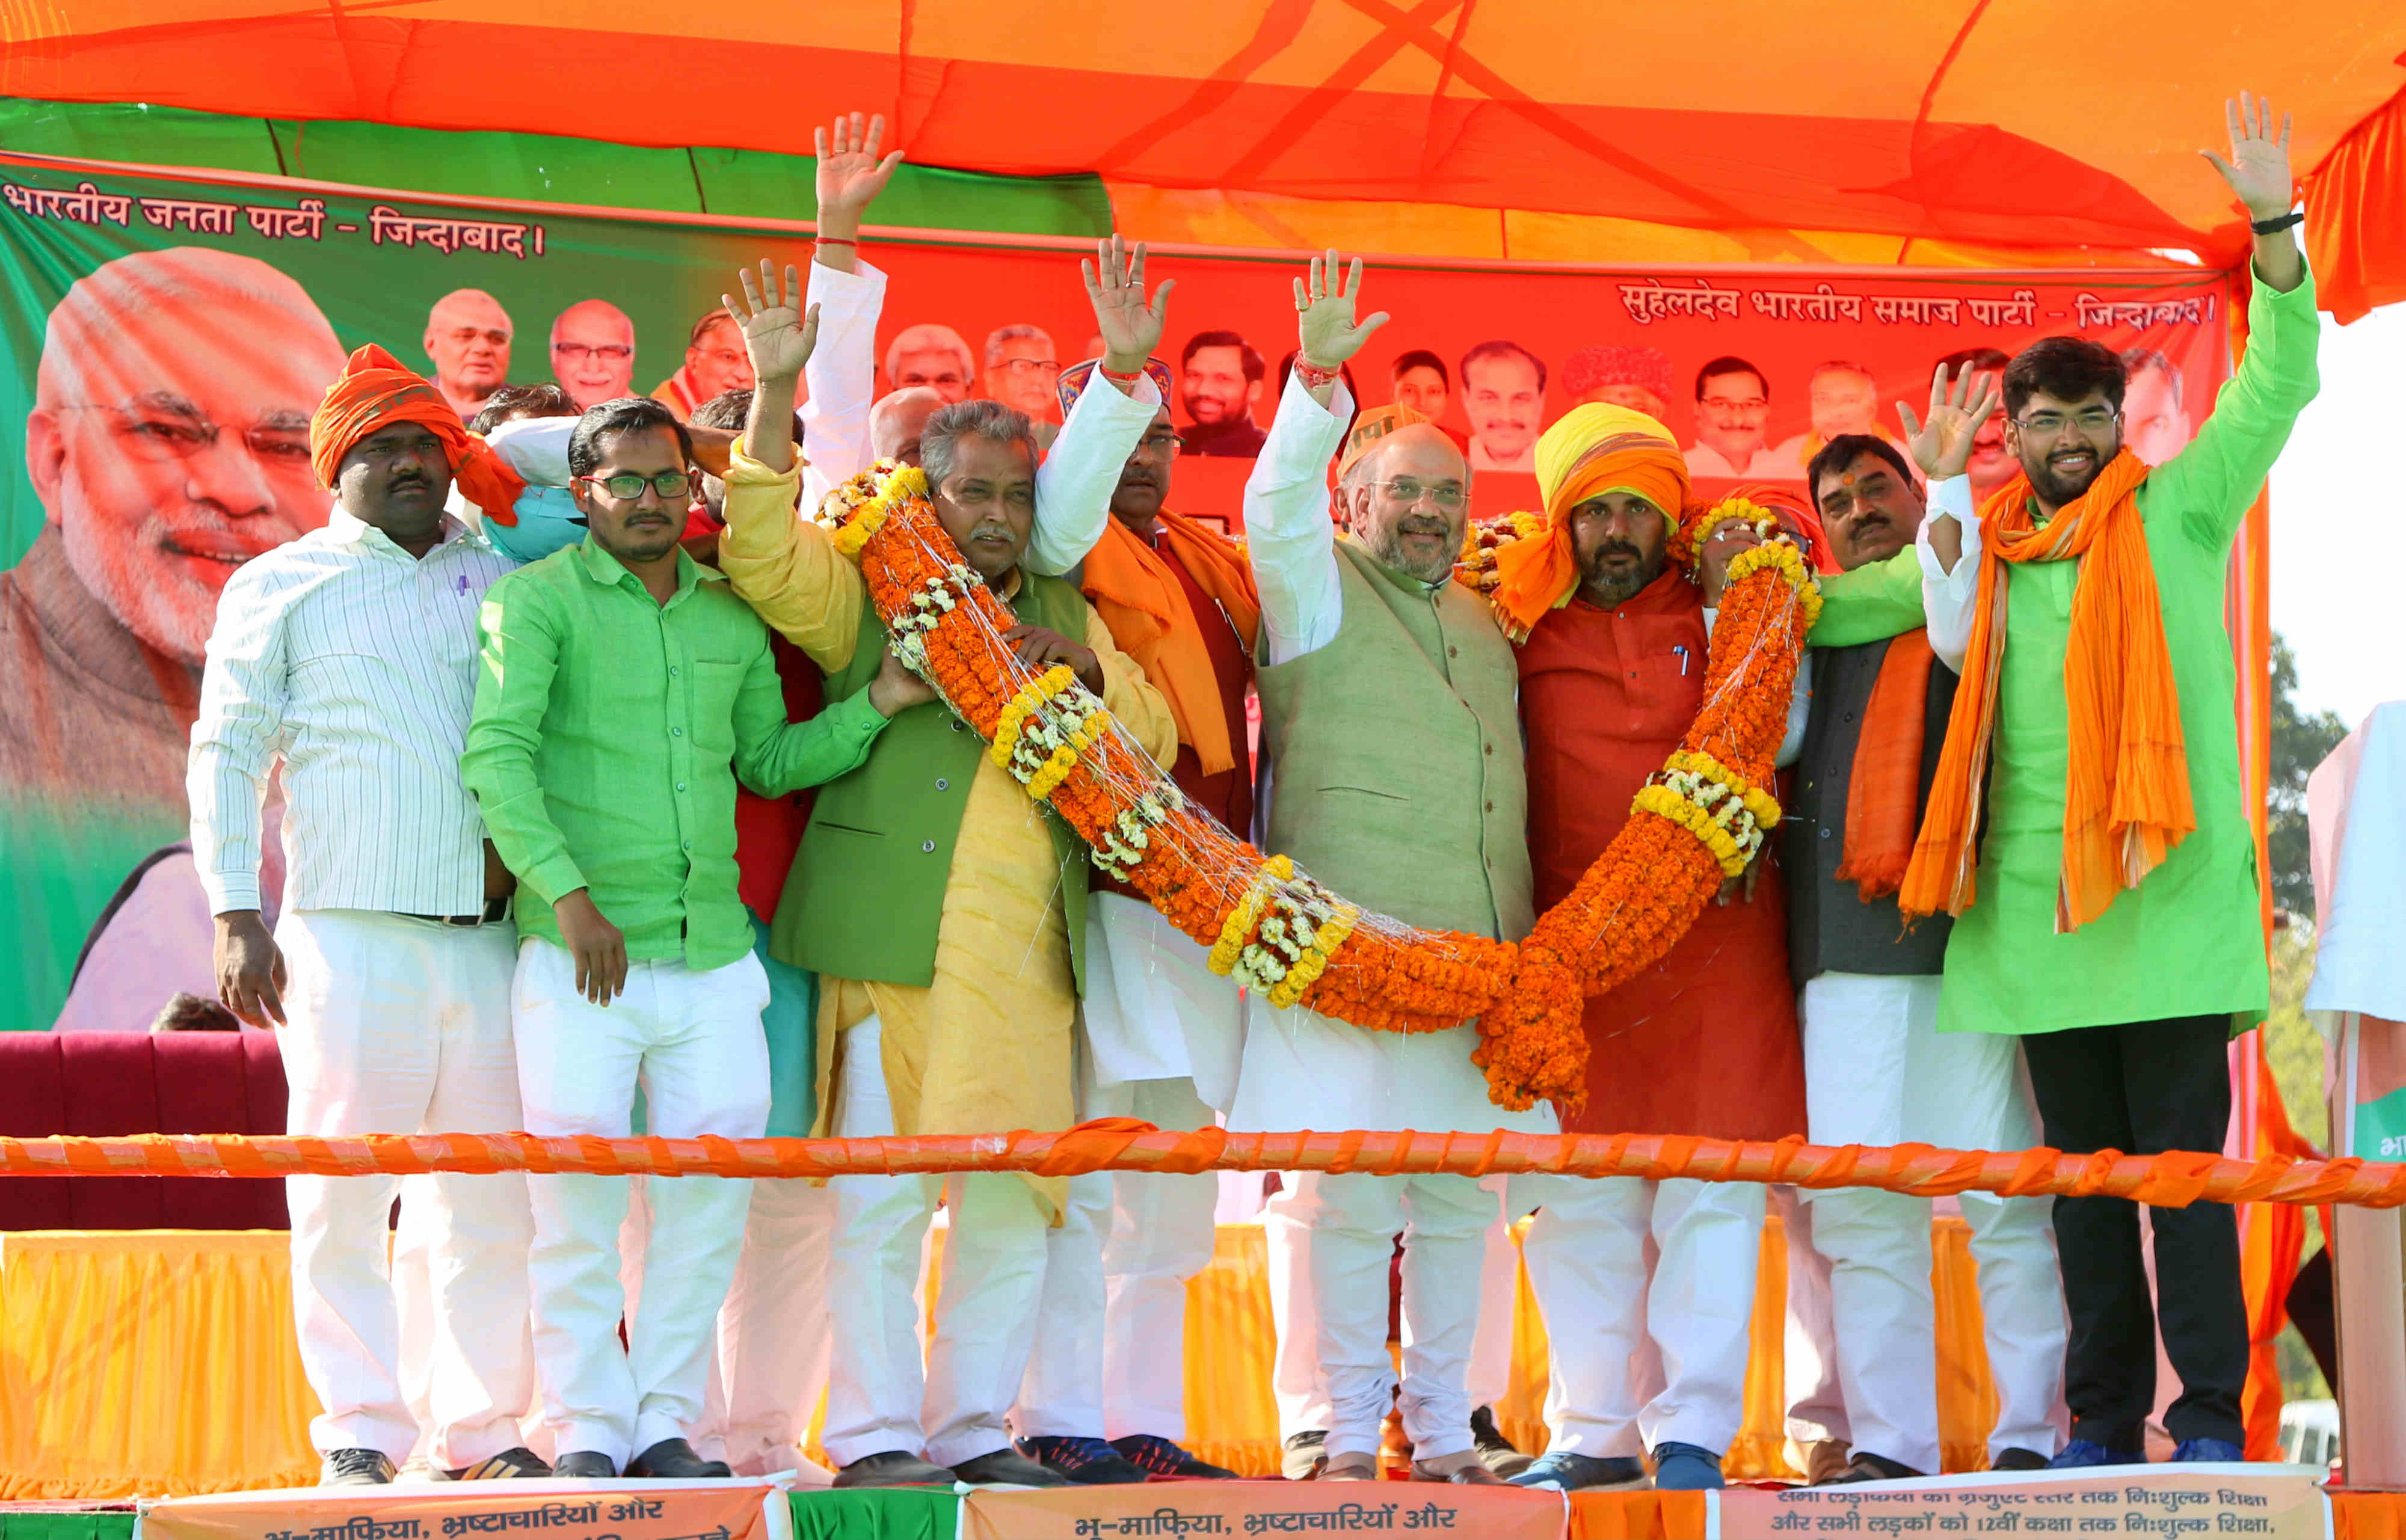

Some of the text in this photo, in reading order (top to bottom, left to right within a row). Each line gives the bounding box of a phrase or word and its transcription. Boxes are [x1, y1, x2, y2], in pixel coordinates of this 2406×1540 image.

[2, 182, 133, 227] भारतीय
[138, 197, 239, 235] जनता
[244, 198, 327, 240] पार्टी
[1618, 278, 1741, 324] सुहेलदेव
[1751, 284, 1863, 322] भारतीय
[1868, 295, 1961, 326] समाज
[1965, 289, 2038, 326] पार्टी
[608, 1497, 665, 1521] और
[2081, 1491, 2118, 1503] तक
[2217, 1489, 2268, 1506] शिक्षा
[1243, 1503, 1399, 1536] भ्रष्टाचारियों
[1403, 1502, 1457, 1530] और
[1771, 1510, 1811, 1530] और
[1817, 1511, 1862, 1531] सभी
[1867, 1512, 1936, 1538] लड़कों
[1939, 1512, 1969, 1531] को
[2025, 1517, 2072, 1532] कक्षा
[2079, 1517, 2117, 1532] तक
